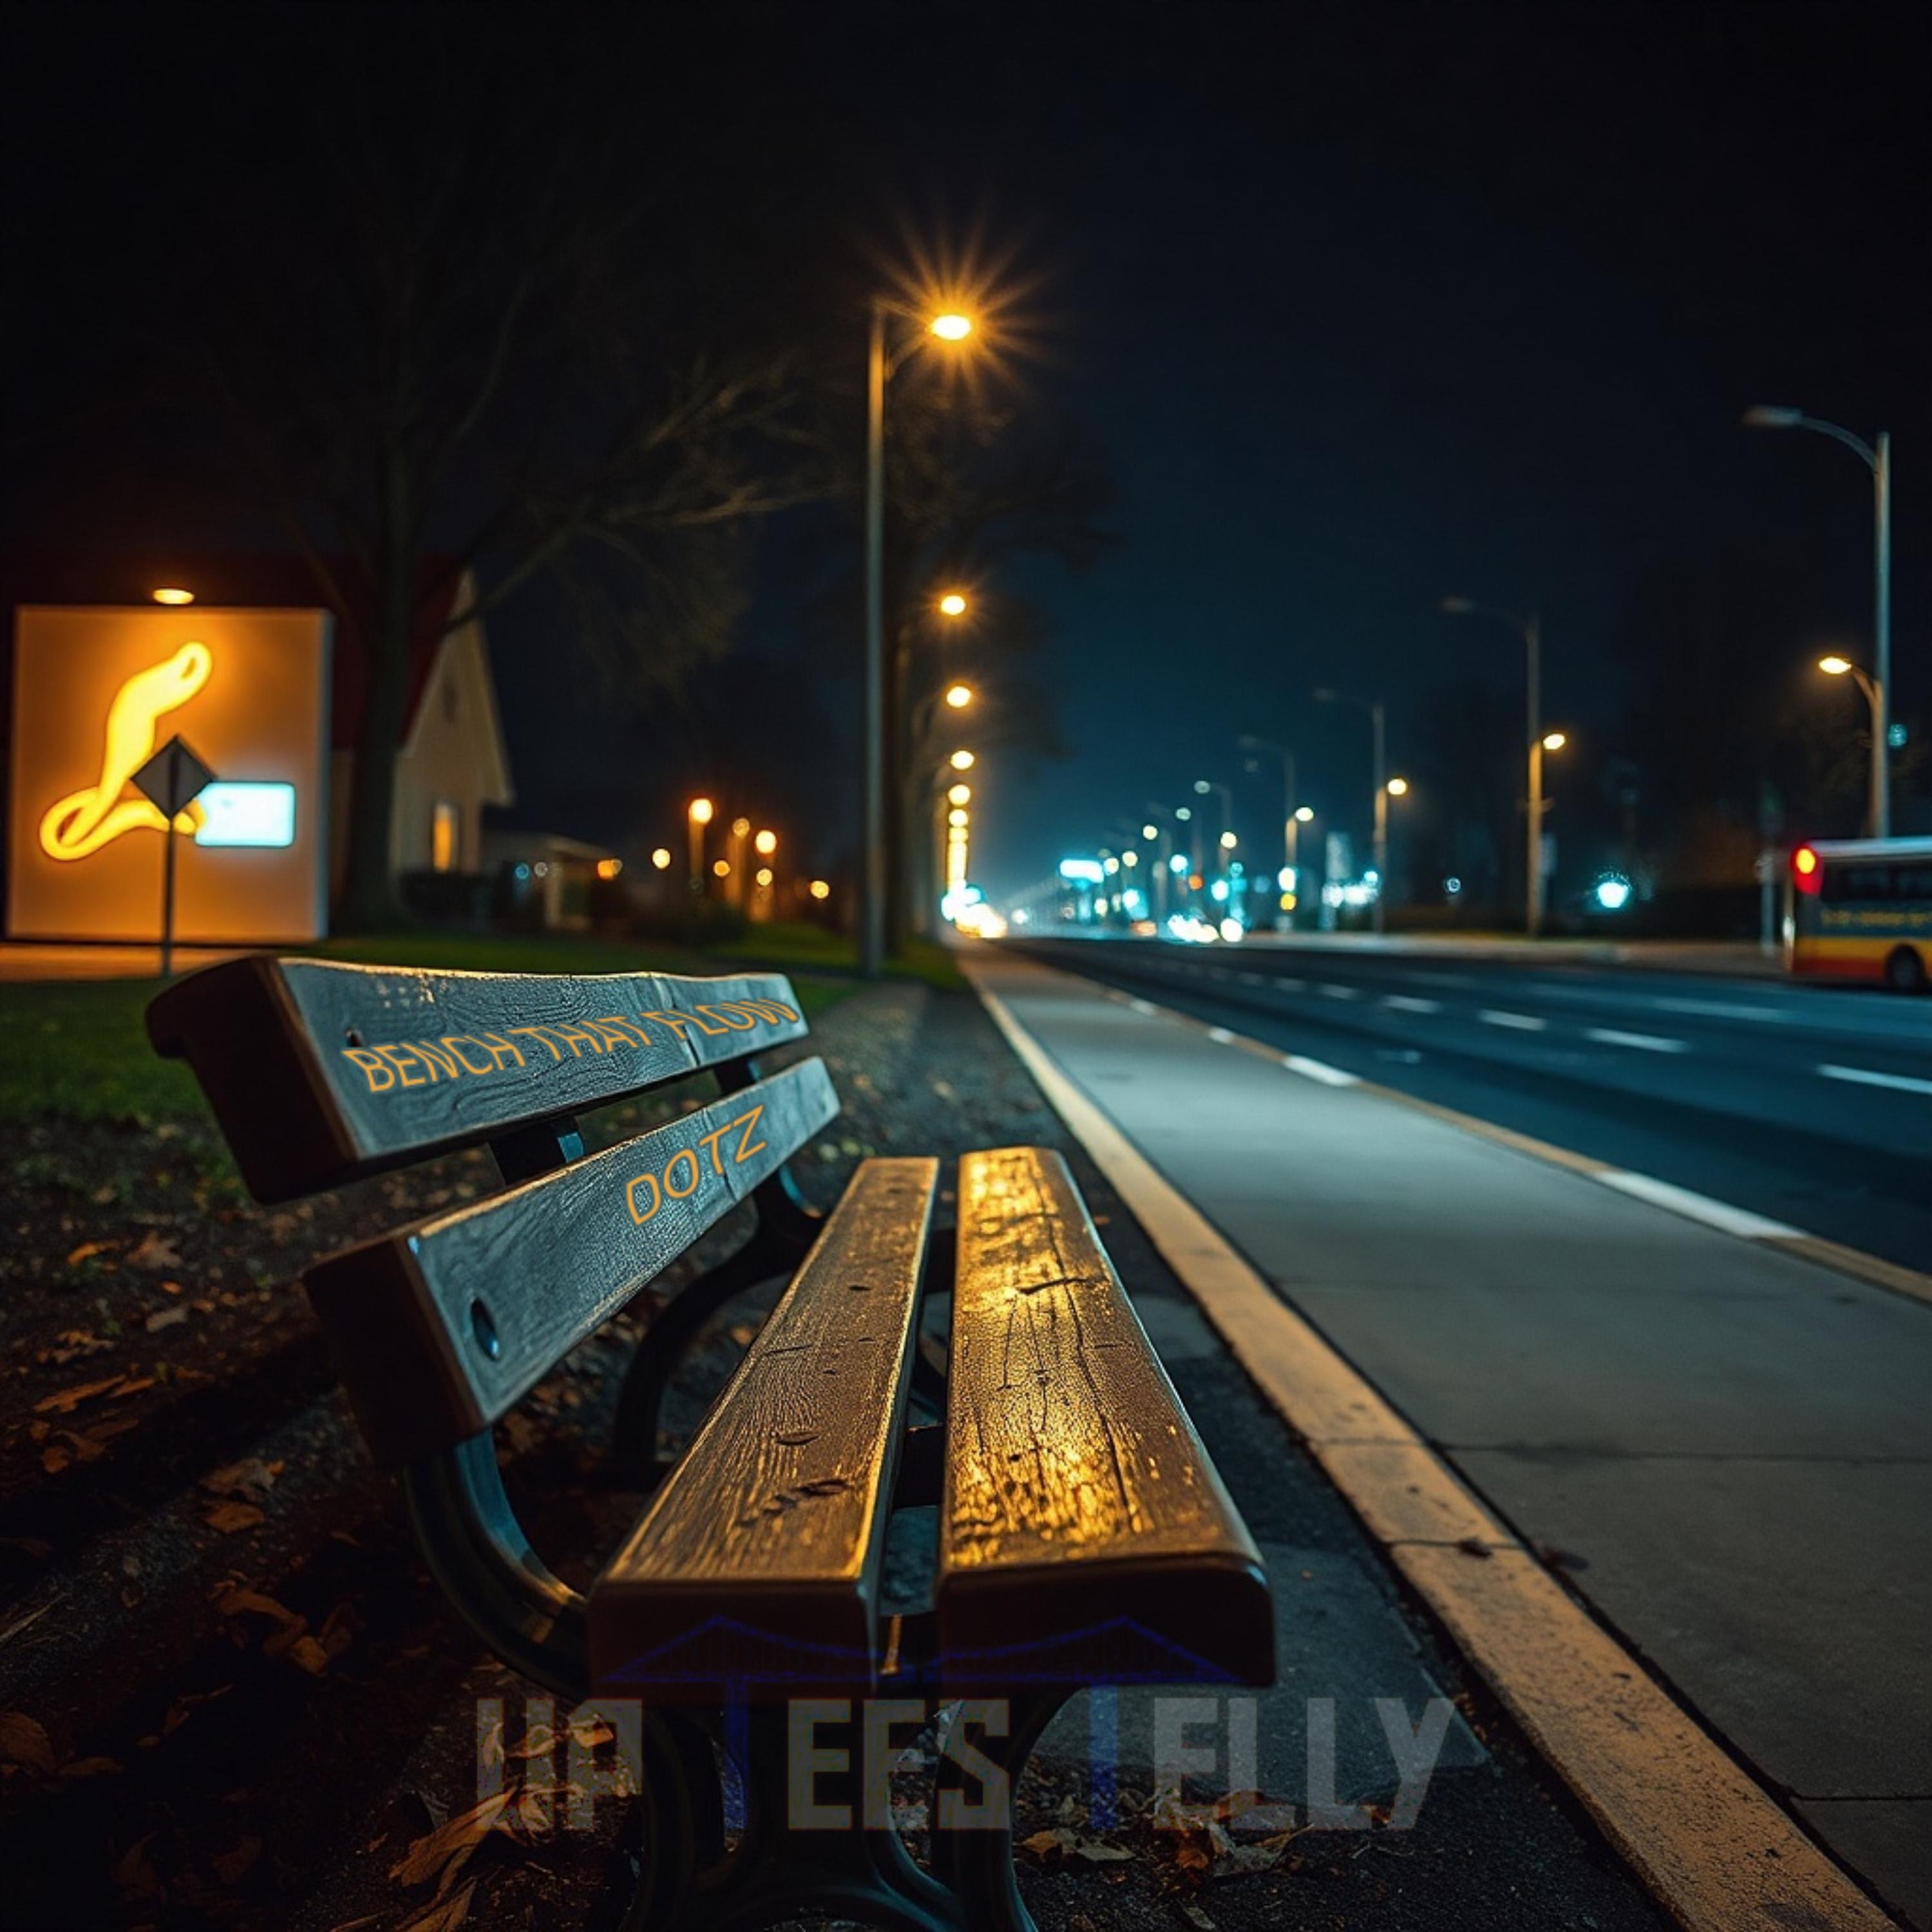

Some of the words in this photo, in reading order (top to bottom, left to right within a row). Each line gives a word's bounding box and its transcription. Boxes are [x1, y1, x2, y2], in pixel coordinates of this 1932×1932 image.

[341, 1032, 526, 1092] BENCH
[506, 1016, 651, 1061] THAT
[639, 998, 799, 1041] FLOW
[625, 1104, 767, 1226] DOTZ
